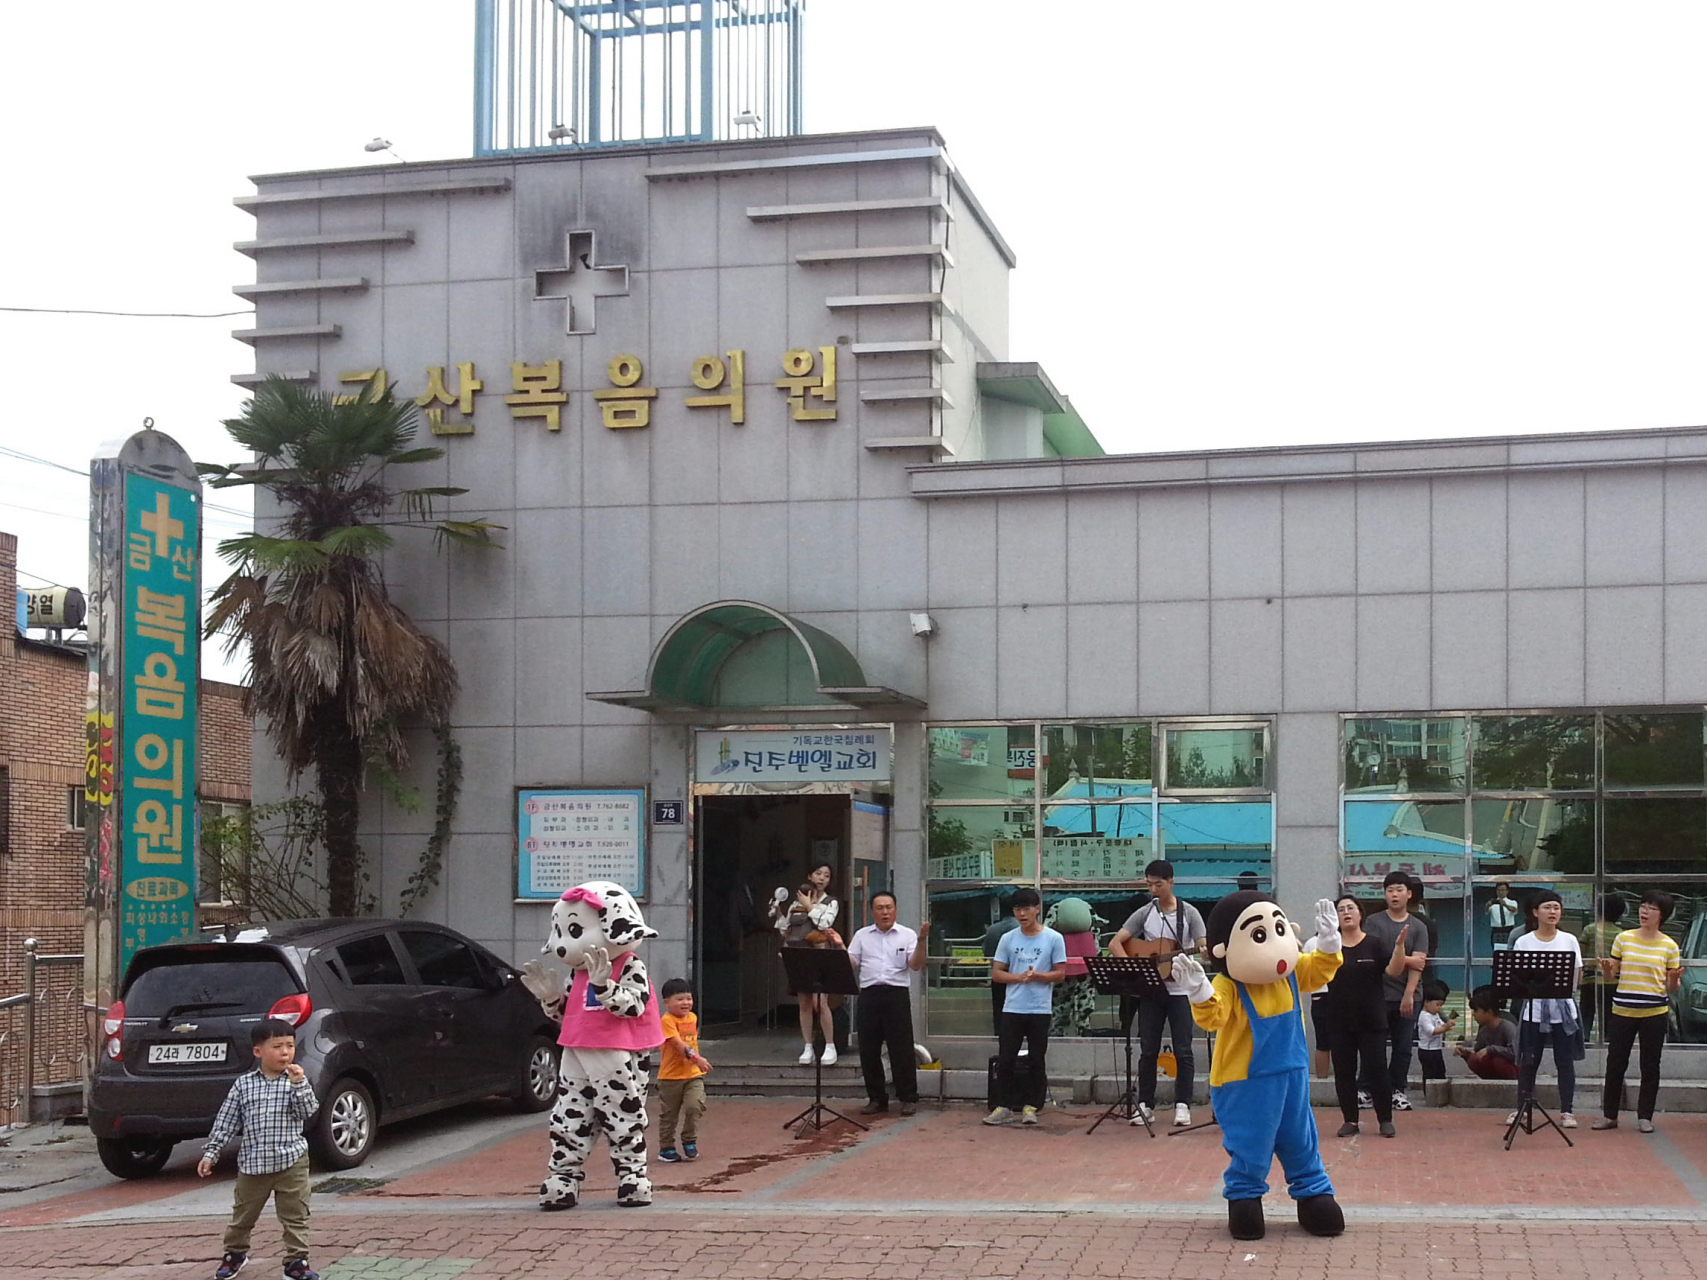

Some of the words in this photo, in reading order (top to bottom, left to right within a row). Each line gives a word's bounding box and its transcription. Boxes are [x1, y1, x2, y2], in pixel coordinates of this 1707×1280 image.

[133, 585, 187, 865] 복음의원
[661, 808, 676, 819] 78
[155, 1046, 180, 1061] 24라
[186, 1044, 220, 1060] 7804
